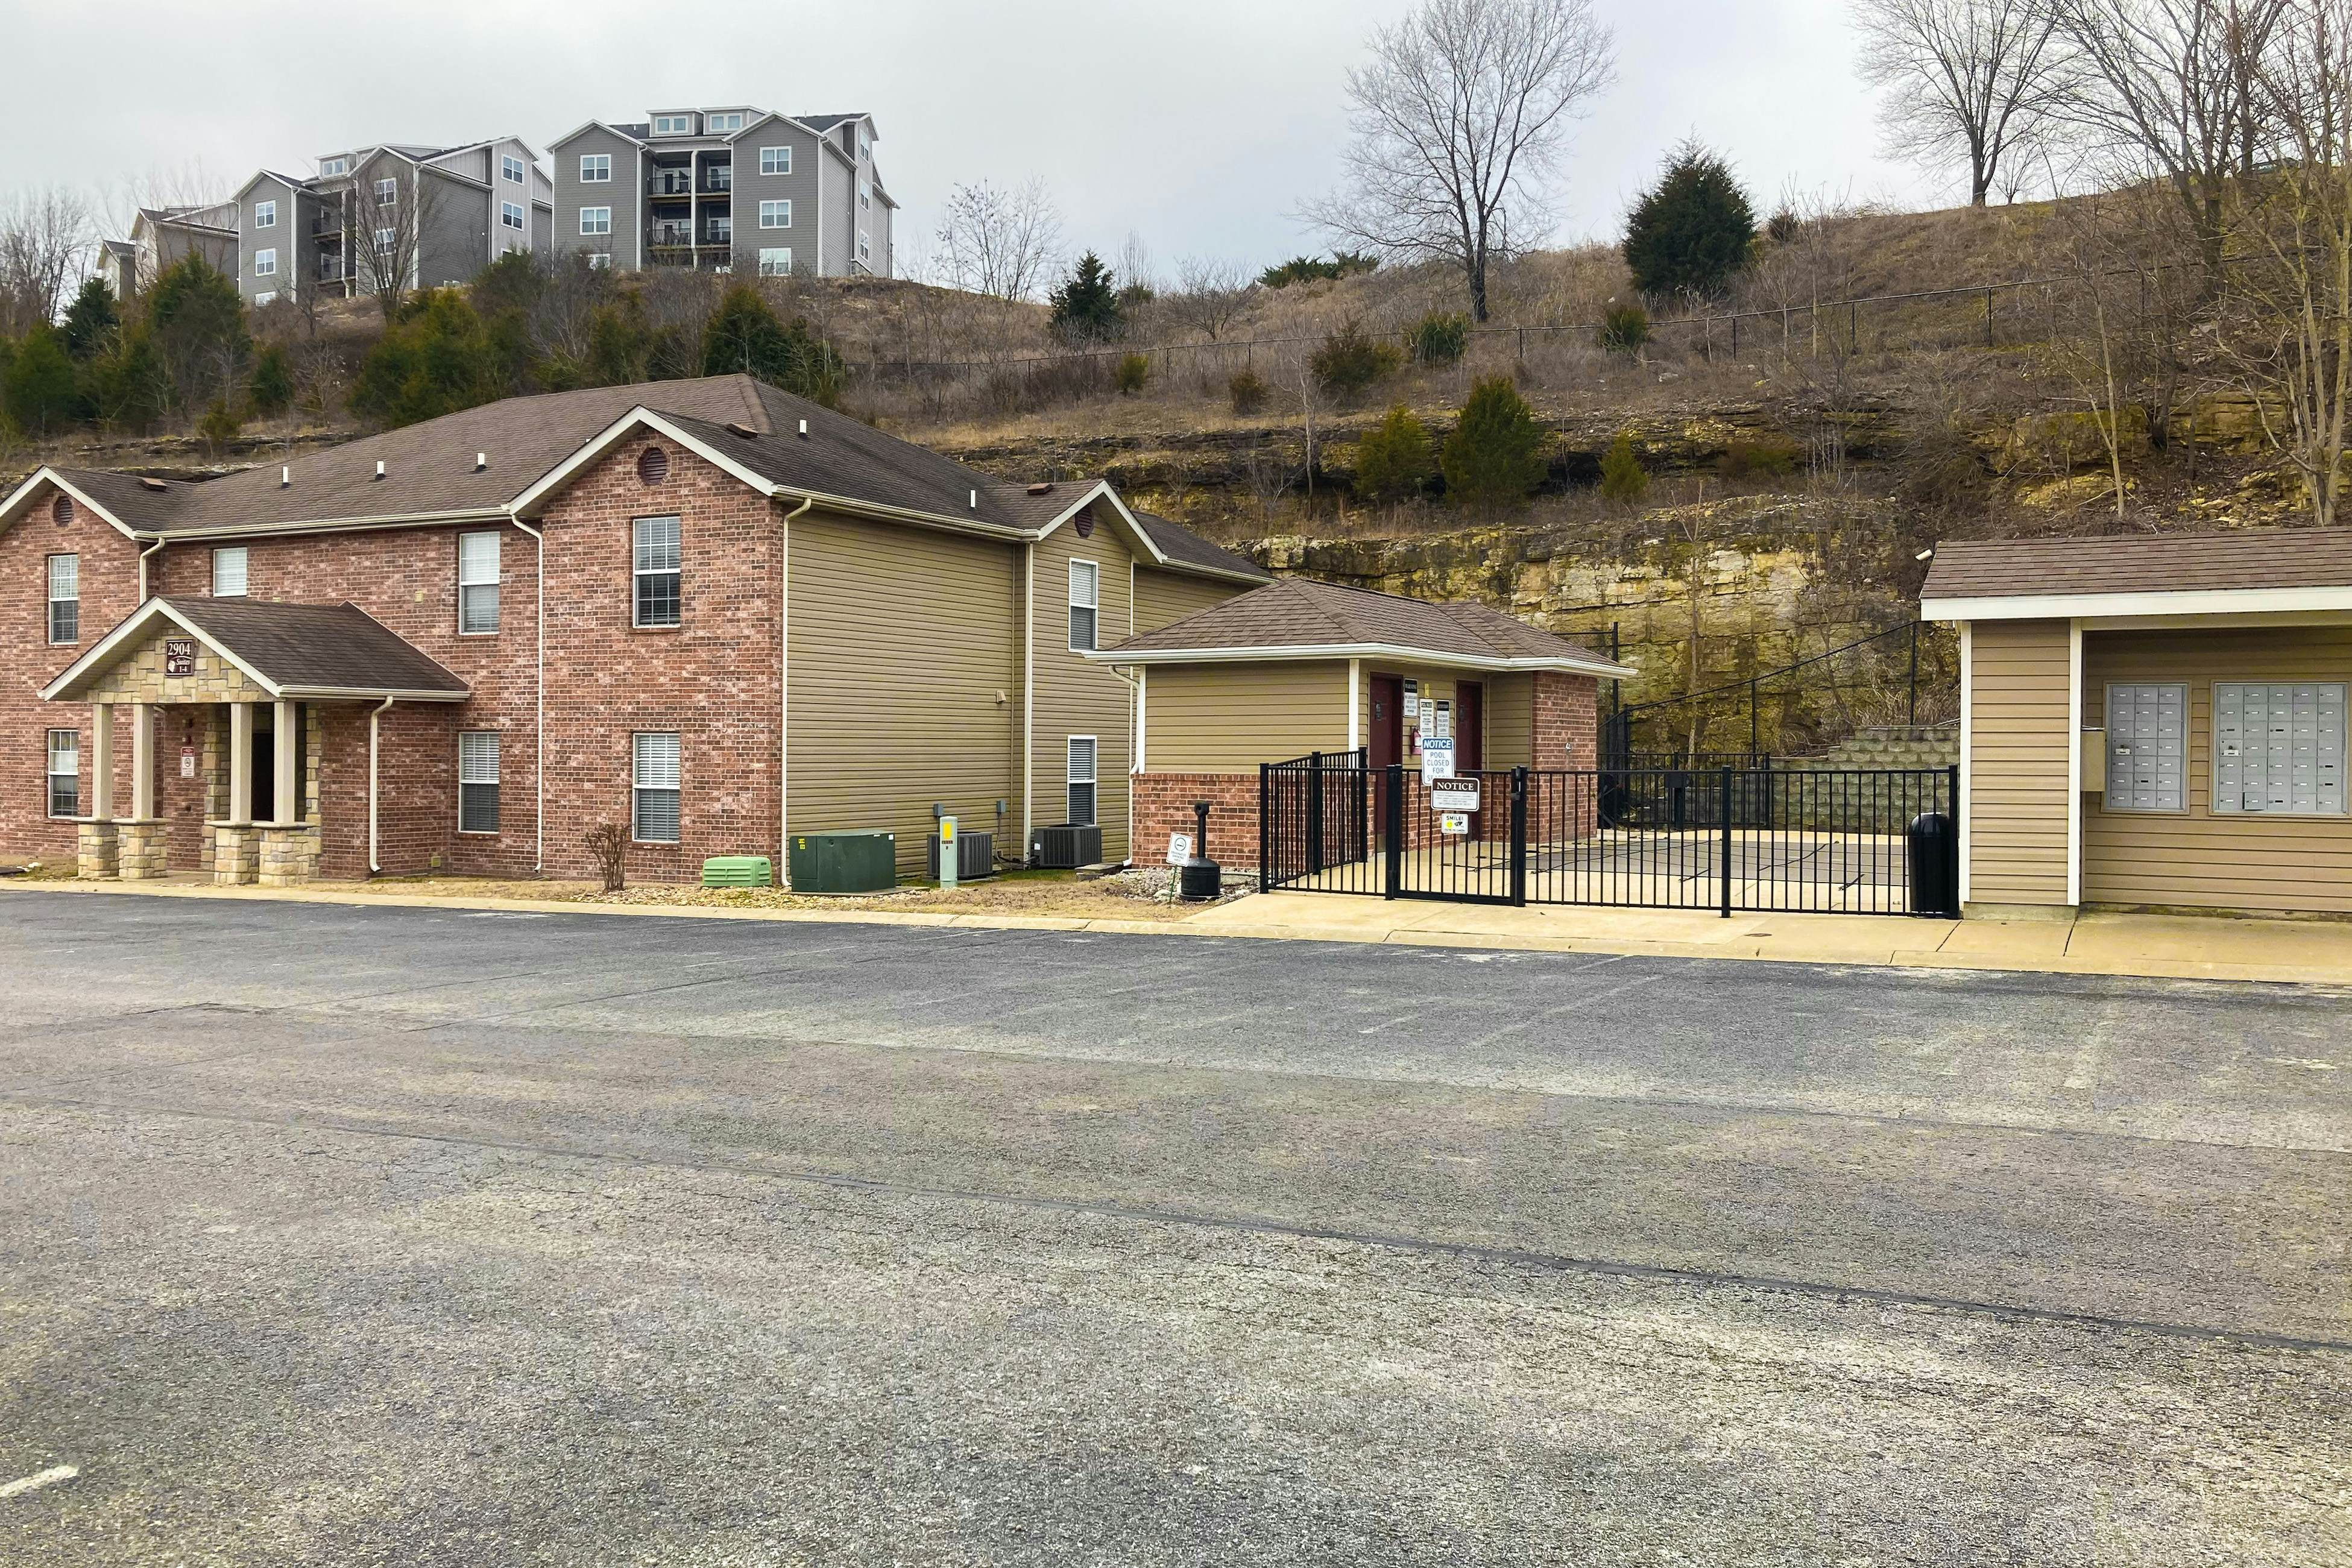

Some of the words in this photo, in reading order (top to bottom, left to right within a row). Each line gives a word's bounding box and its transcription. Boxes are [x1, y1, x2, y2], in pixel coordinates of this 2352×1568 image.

[168, 643, 191, 655] 2904
[1423, 740, 1452, 749] NOTICE
[1437, 782, 1474, 791] NOTICE
